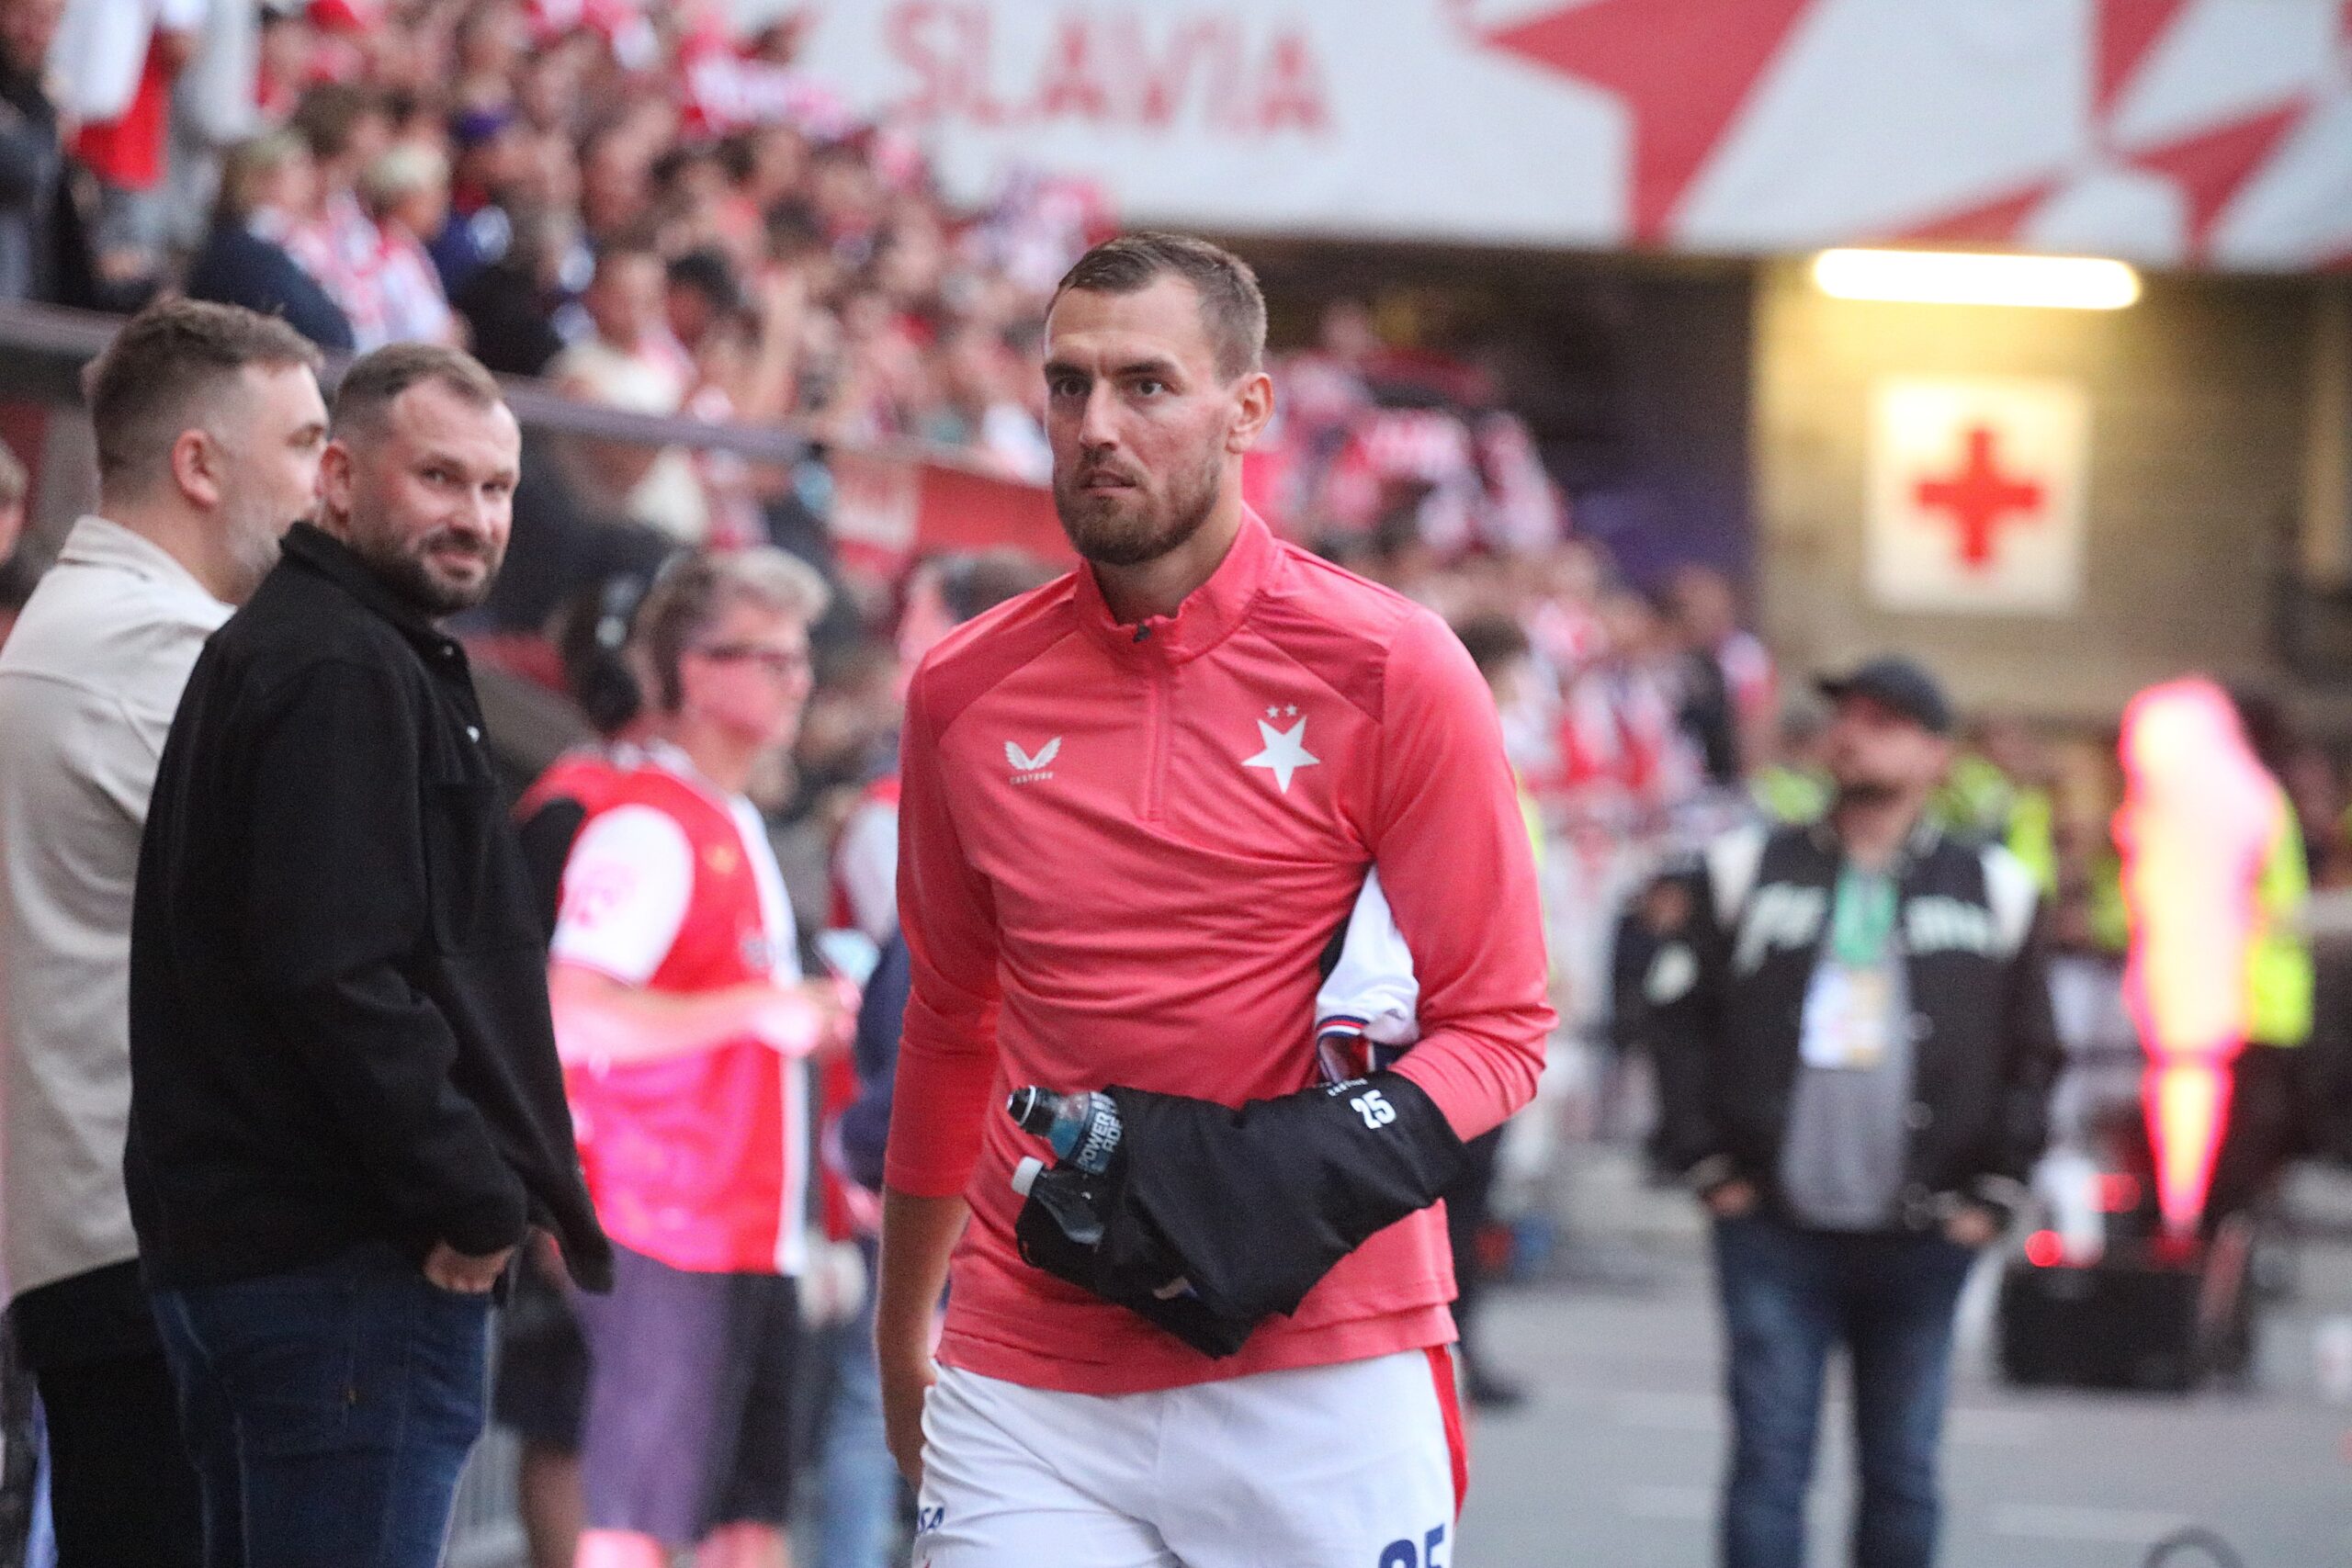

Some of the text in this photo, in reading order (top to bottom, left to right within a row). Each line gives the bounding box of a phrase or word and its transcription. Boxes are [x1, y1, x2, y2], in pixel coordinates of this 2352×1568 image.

[884, 0, 1338, 134] SLAVIA
[1350, 1089, 1396, 1130] 25
[1077, 1111, 1114, 1168] POWER
